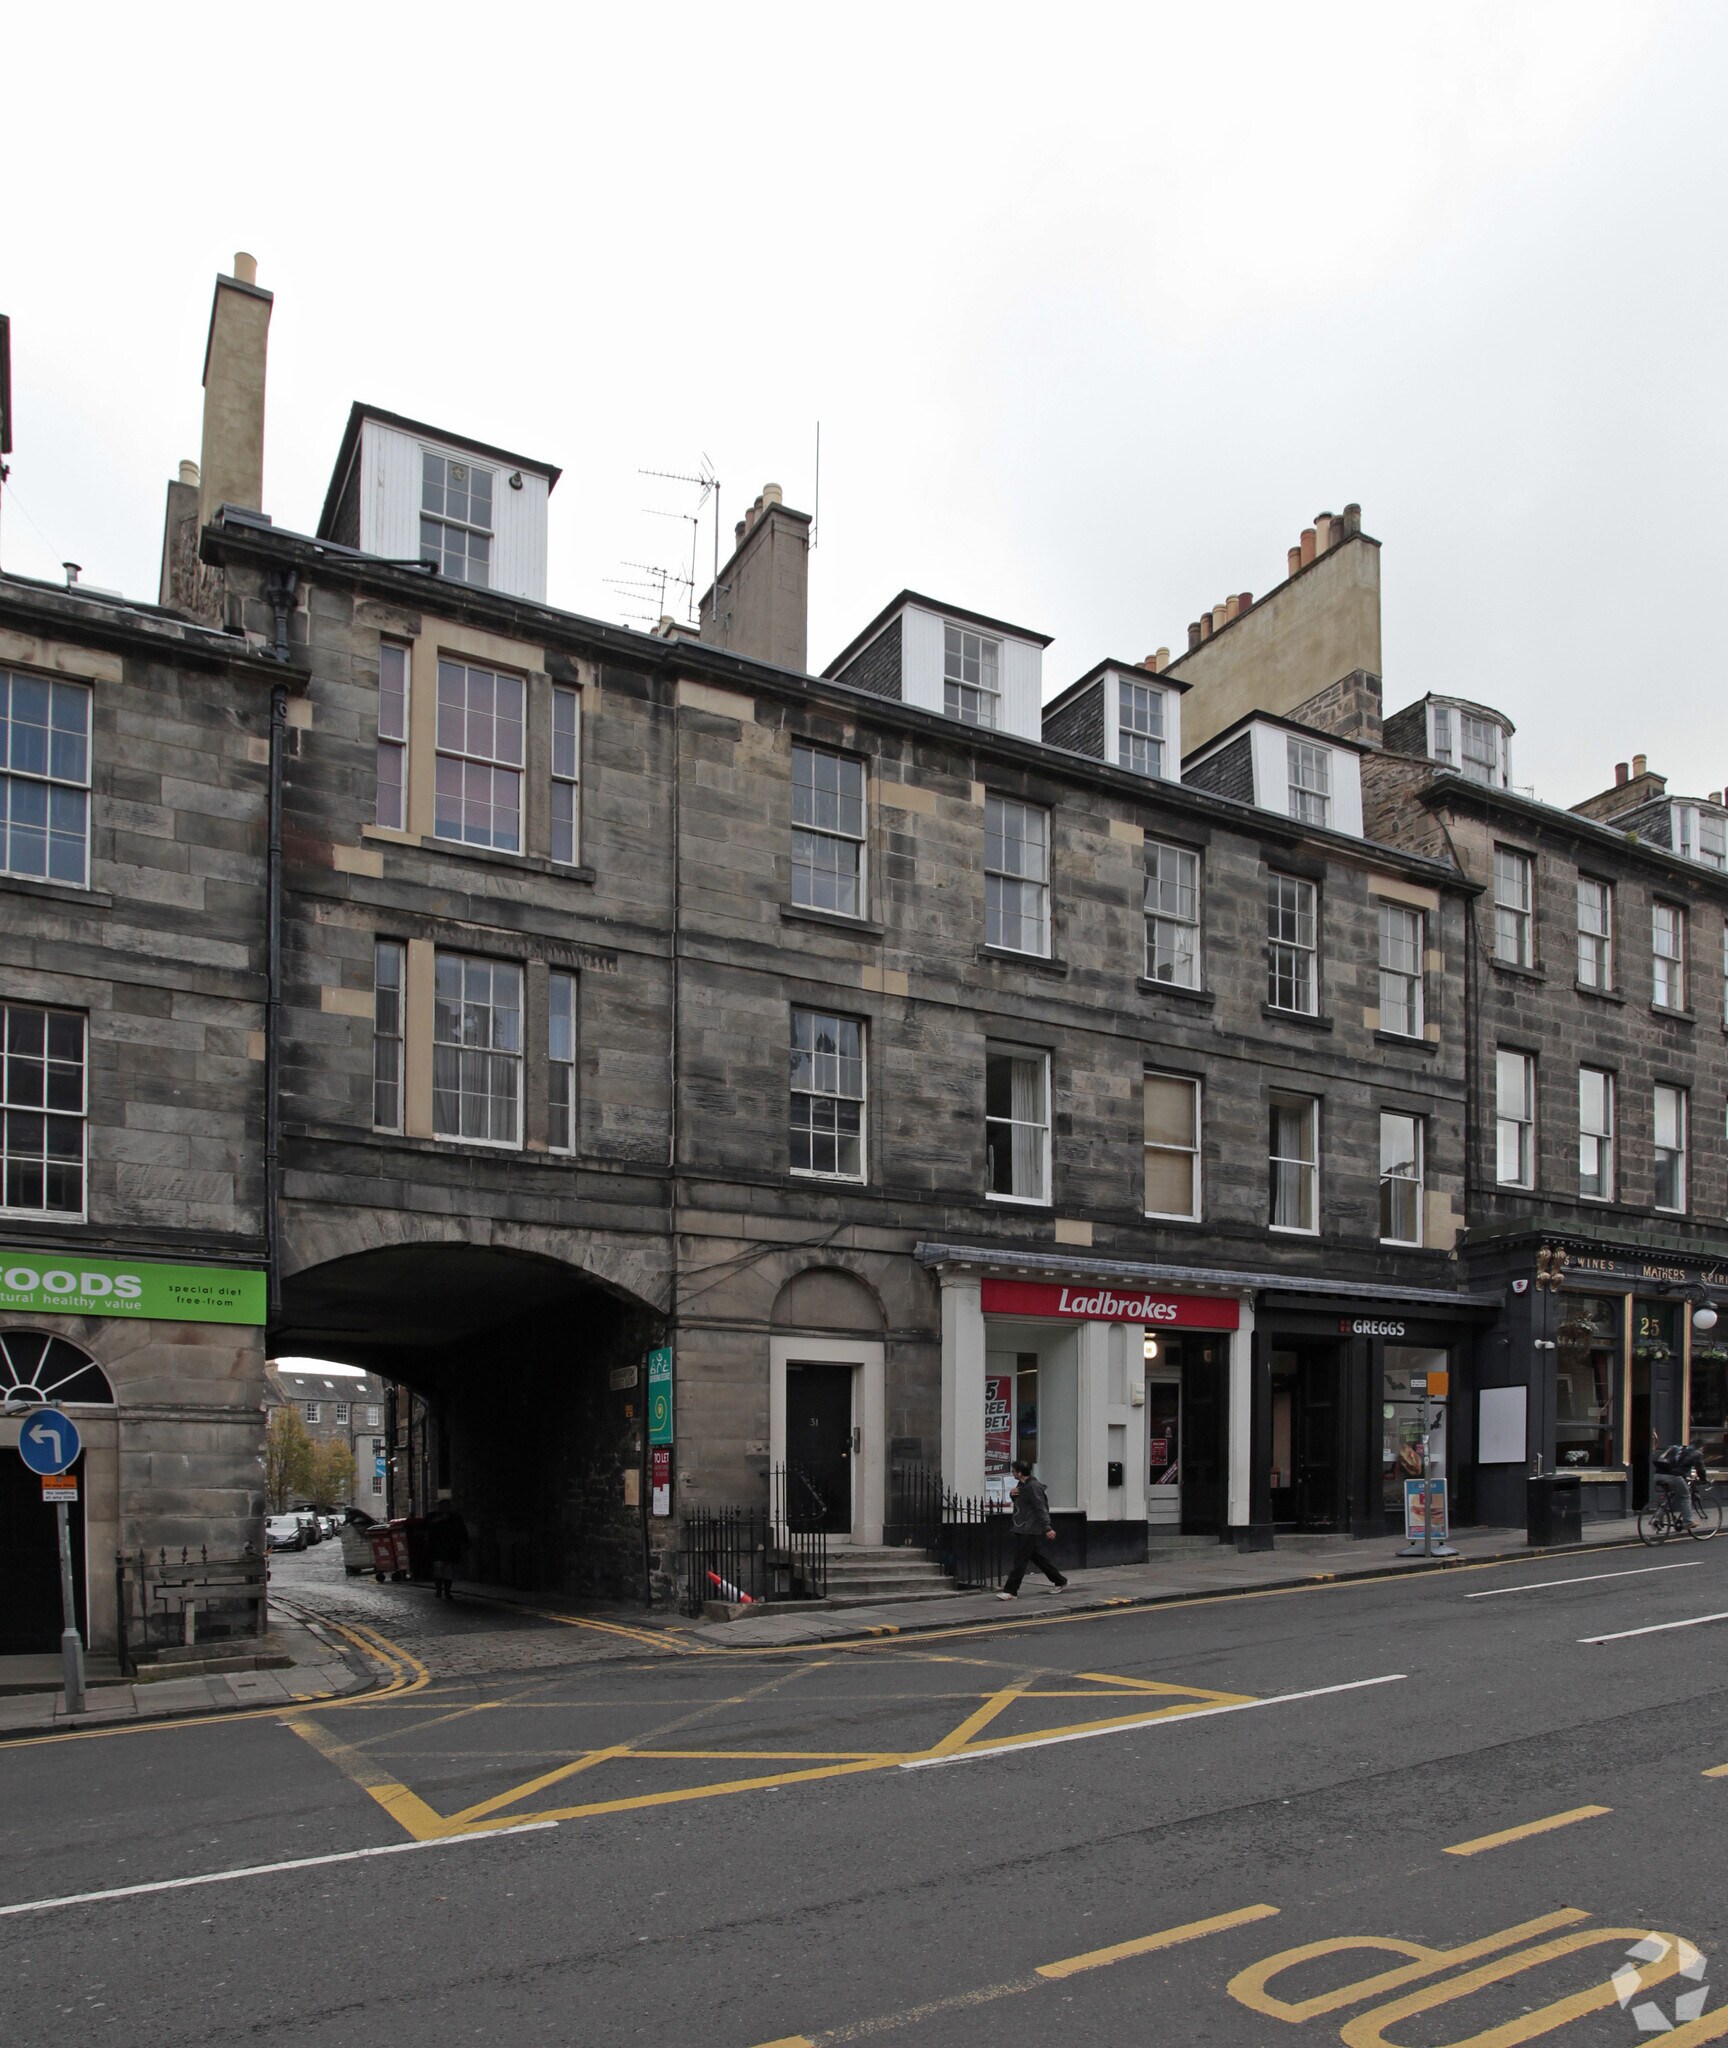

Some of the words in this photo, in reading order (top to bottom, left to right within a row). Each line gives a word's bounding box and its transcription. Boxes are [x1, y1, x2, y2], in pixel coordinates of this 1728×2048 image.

[1577, 1256, 1614, 1271] WINES
[1642, 1265, 1686, 1281] MATHERS
[0, 1266, 142, 1298] OODS
[168, 1284, 213, 1294] special
[218, 1287, 242, 1296] diet
[43, 1294, 96, 1309] healthy
[104, 1299, 142, 1310] value
[176, 1295, 234, 1306] free-from
[1058, 1288, 1178, 1320] Ladbrokes
[1352, 1319, 1405, 1337] GREGGS
[1640, 1317, 1660, 1336] 25
[809, 1417, 819, 1427] 31
[653, 1453, 661, 1463] TO
[661, 1452, 670, 1463] LET
